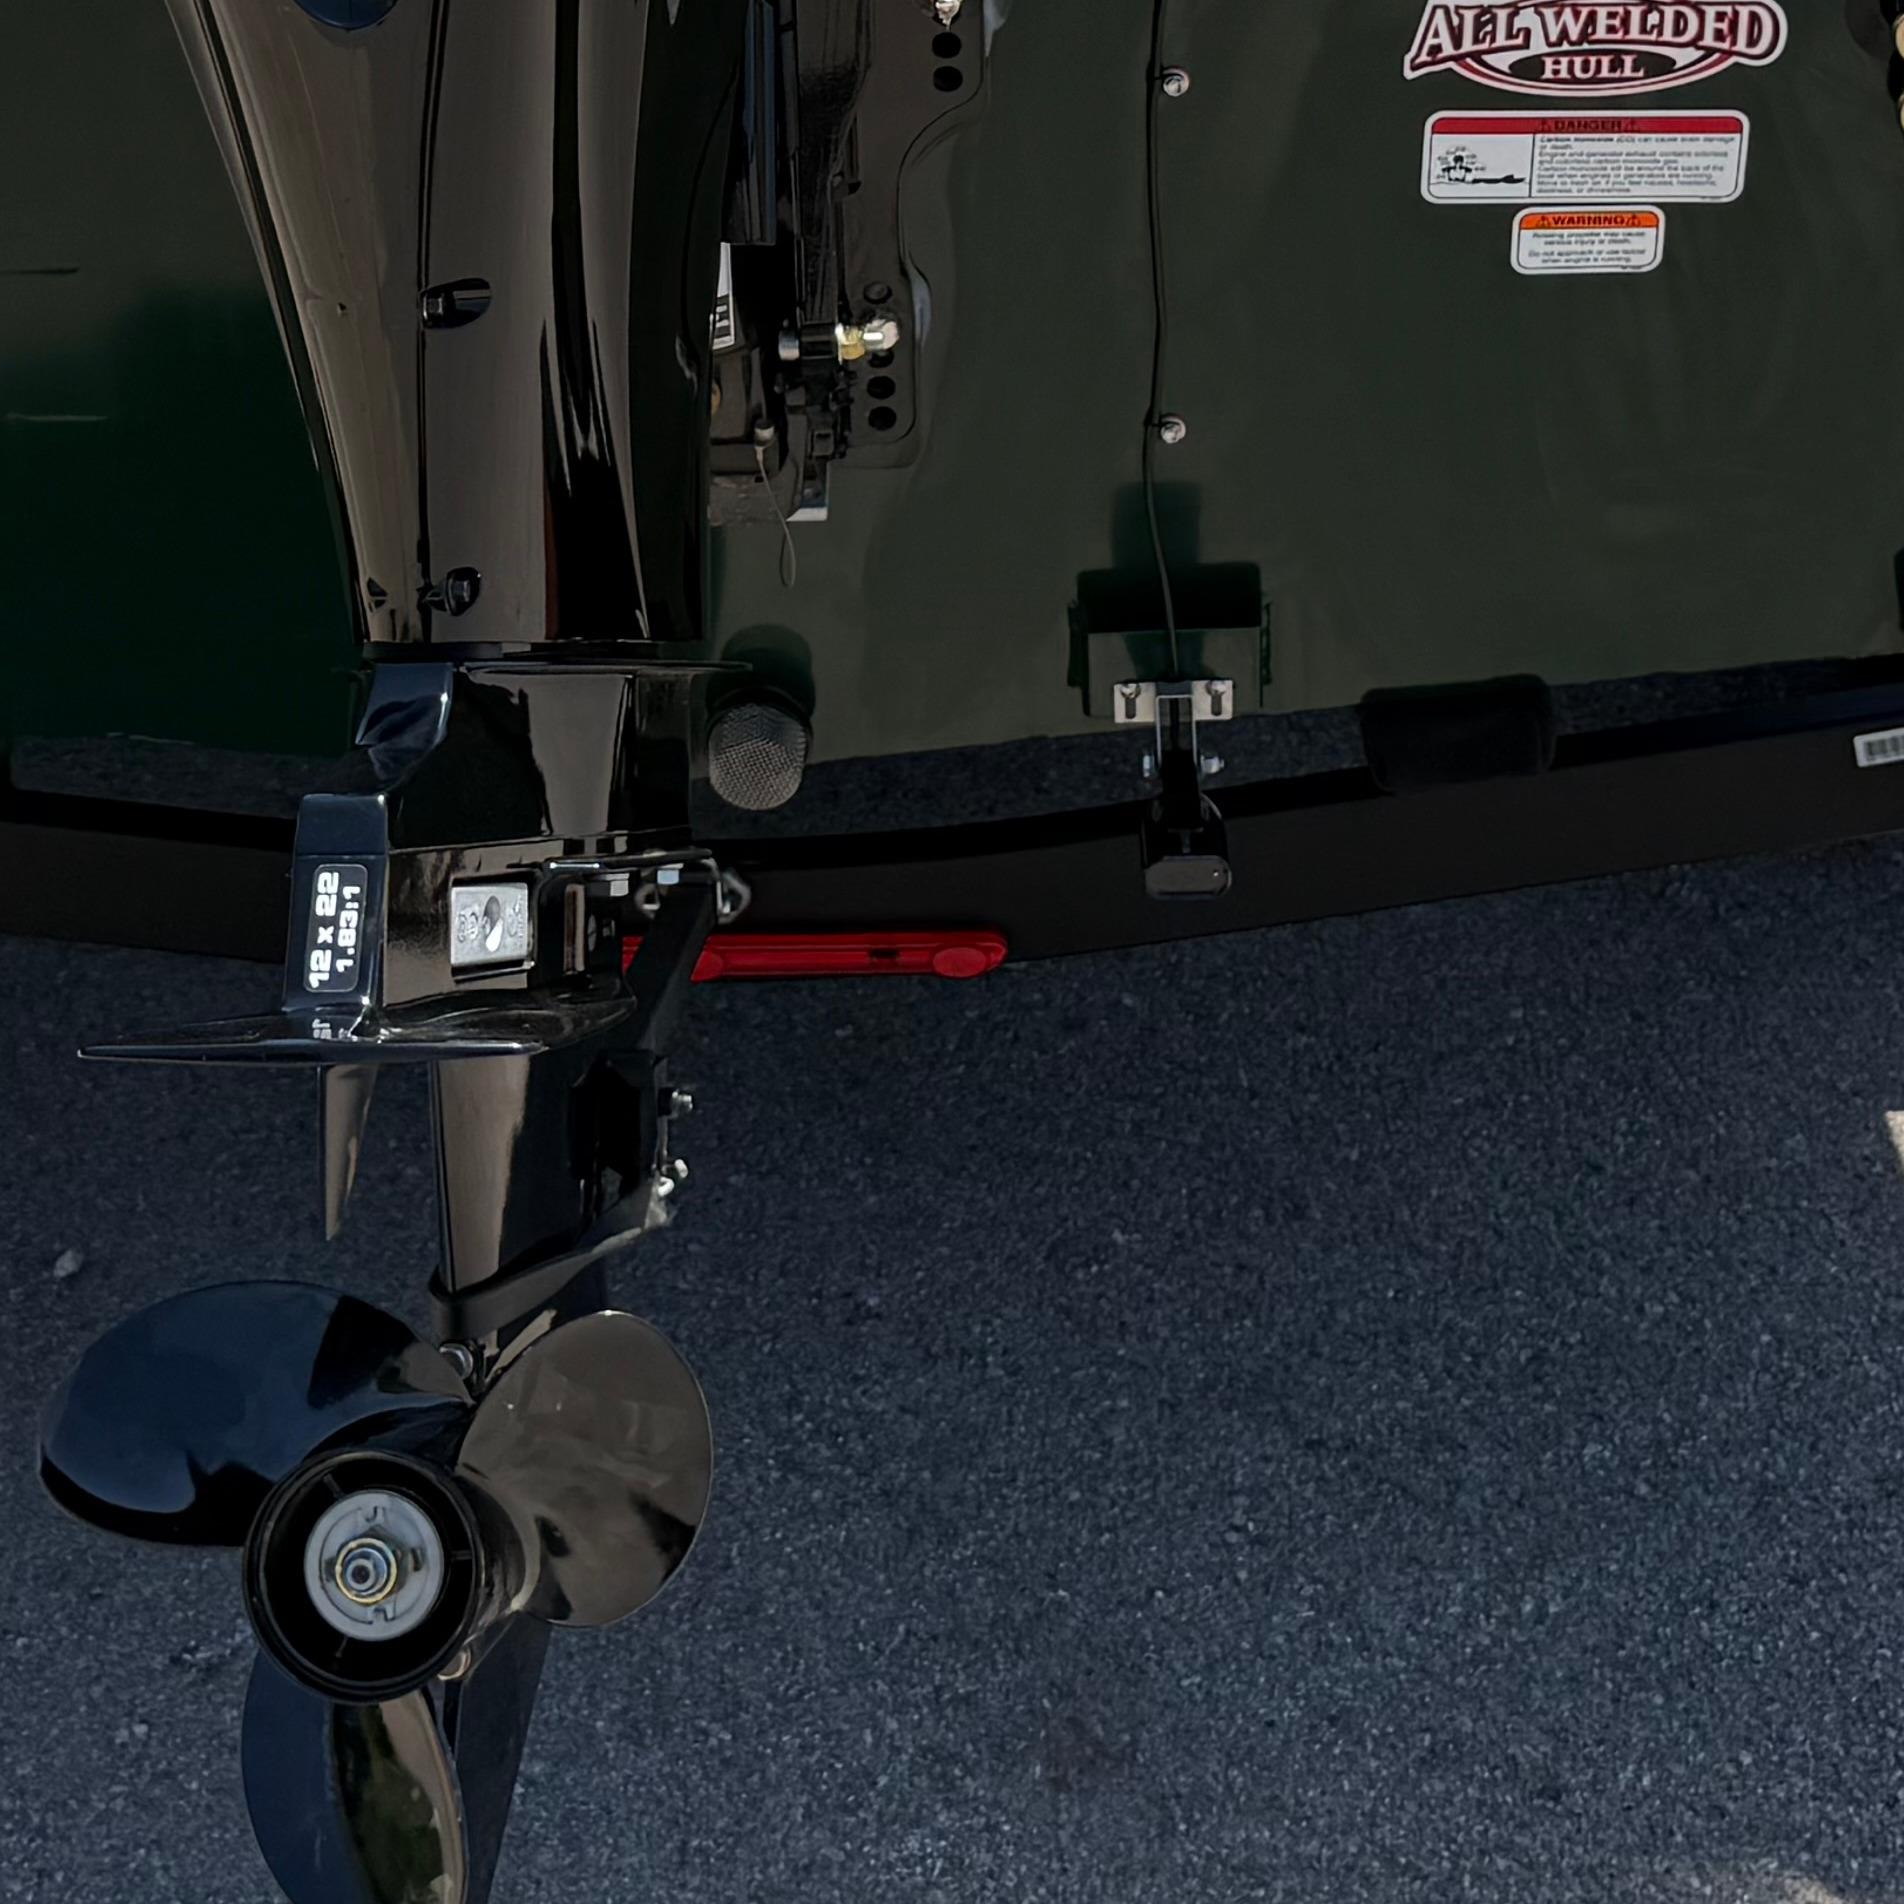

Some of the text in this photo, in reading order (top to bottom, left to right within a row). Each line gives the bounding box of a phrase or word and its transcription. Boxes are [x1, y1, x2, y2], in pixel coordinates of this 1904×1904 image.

[1412, 1, 1776, 67] ALL WELDED
[1541, 55, 1645, 80] HULL
[1554, 120, 1622, 131] DANGER
[1552, 215, 1626, 226] WARNING
[315, 871, 339, 917] 22
[335, 885, 360, 973] 1.83:1
[307, 948, 333, 988] 12
